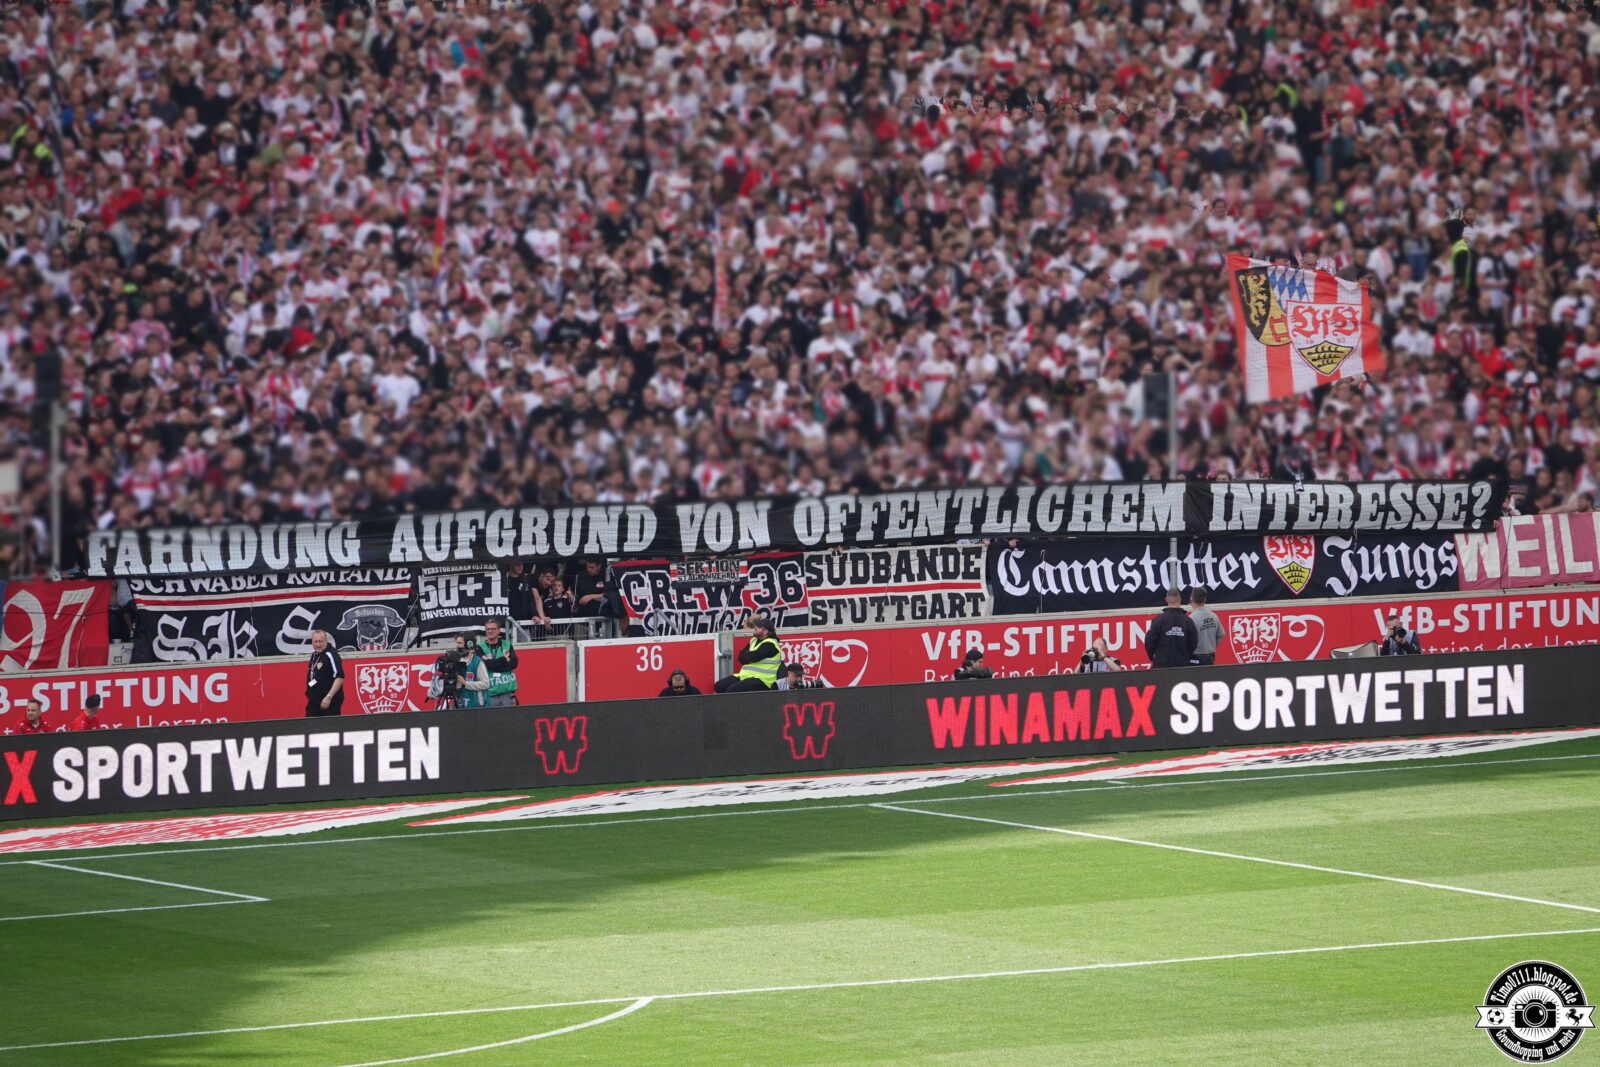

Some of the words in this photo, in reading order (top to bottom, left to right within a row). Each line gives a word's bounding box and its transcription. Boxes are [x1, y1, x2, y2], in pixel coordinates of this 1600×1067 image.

[1290, 305, 1359, 339] VfB
[87, 521, 361, 576] FAHNDUNG
[388, 504, 657, 562] AUFGRUND
[676, 501, 772, 552] VON
[1209, 481, 1492, 530] INTERESSE?
[620, 569, 745, 615] CREW
[748, 561, 806, 606] 36
[997, 543, 1262, 597] Cannstatter
[1323, 536, 1458, 596] Jungs
[418, 570, 509, 610] 50+1
[811, 592, 986, 626] STUTTGART
[1232, 616, 1278, 644] VfB
[359, 664, 408, 695] VfB
[636, 645, 663, 672] 36
[926, 685, 1156, 749] WINAMAX
[1170, 664, 1524, 735] SPORTWETTEN
[52, 726, 440, 803] SPORTWETTEN
